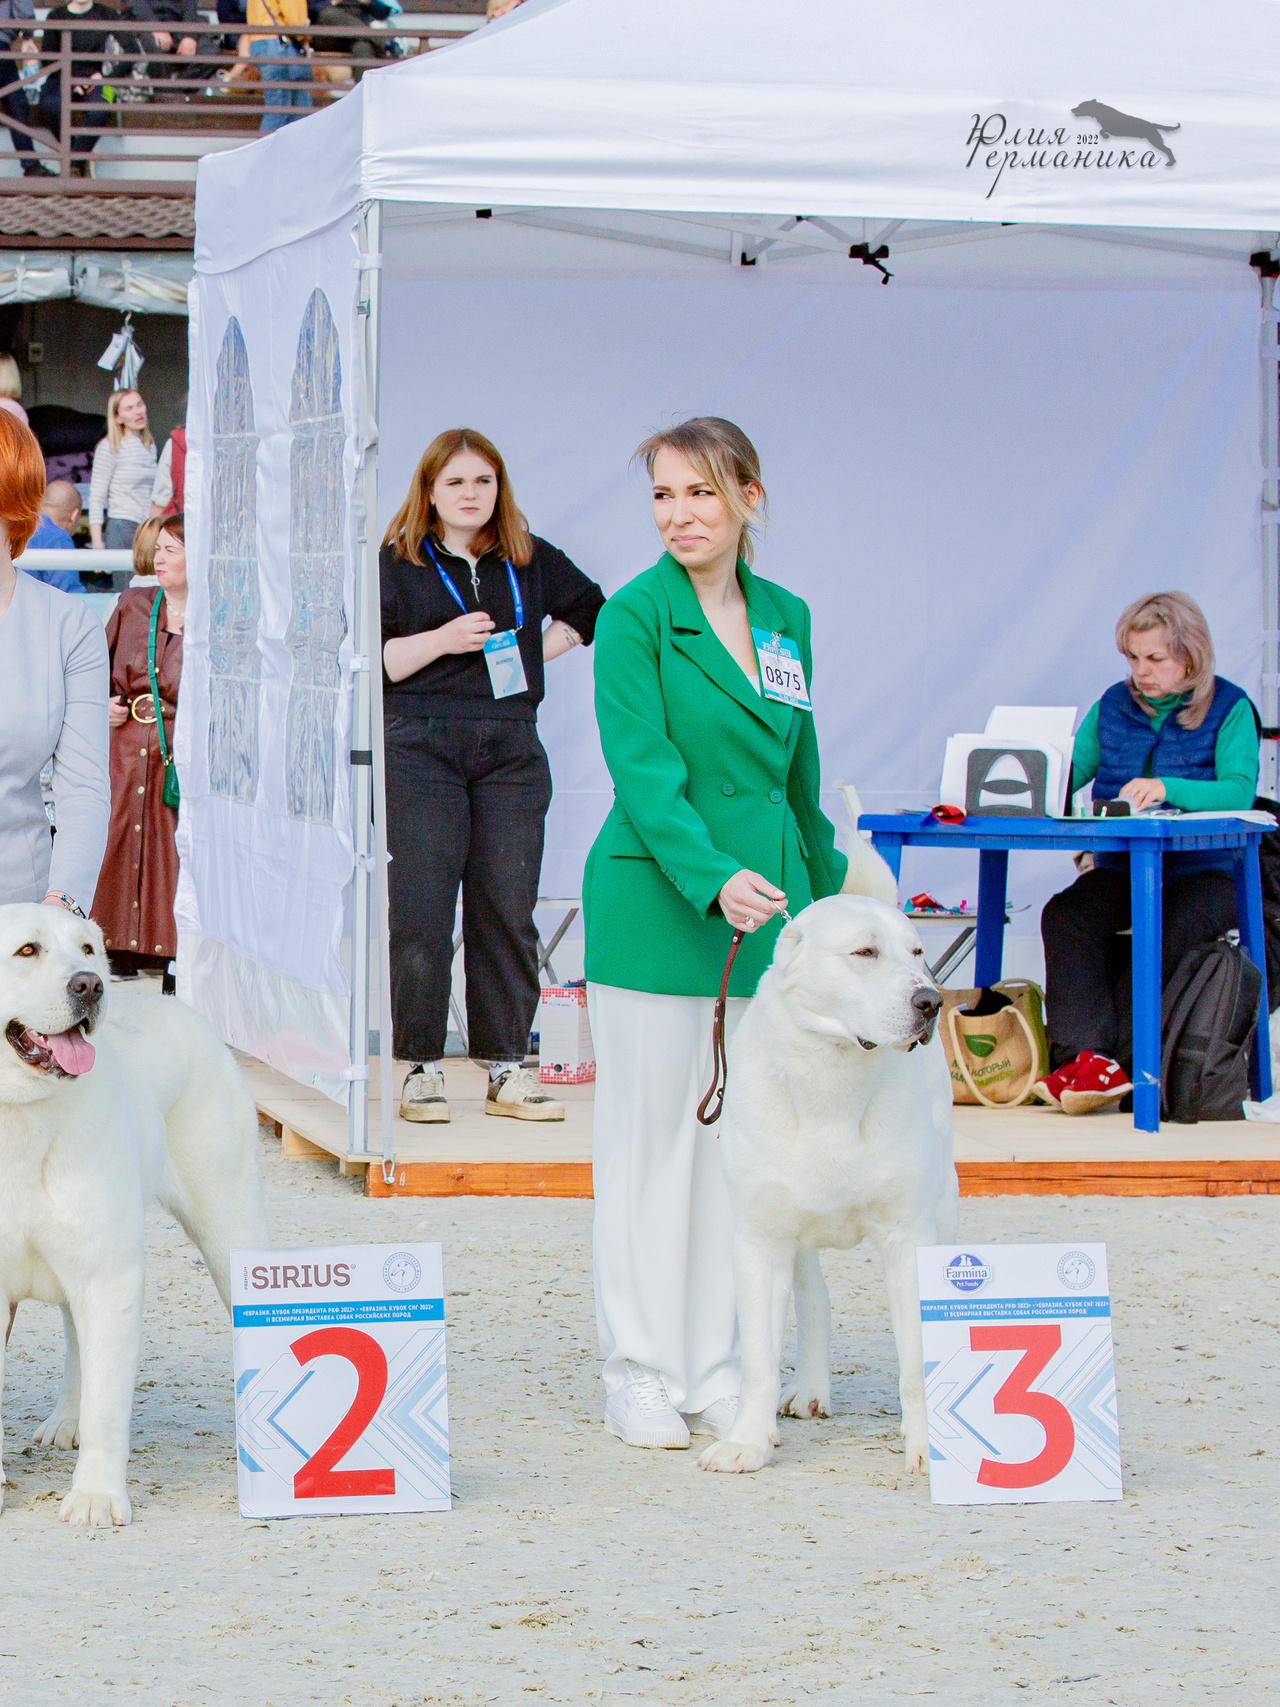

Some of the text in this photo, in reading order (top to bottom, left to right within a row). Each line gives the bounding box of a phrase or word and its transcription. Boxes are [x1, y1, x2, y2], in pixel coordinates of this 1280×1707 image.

[765, 665, 801, 691] 0875
[971, 1057, 1012, 1077] КОТОРЫЙ
[946, 1268, 988, 1278] Farmina
[289, 1326, 395, 1499] 2
[969, 1324, 1075, 1489] 3
